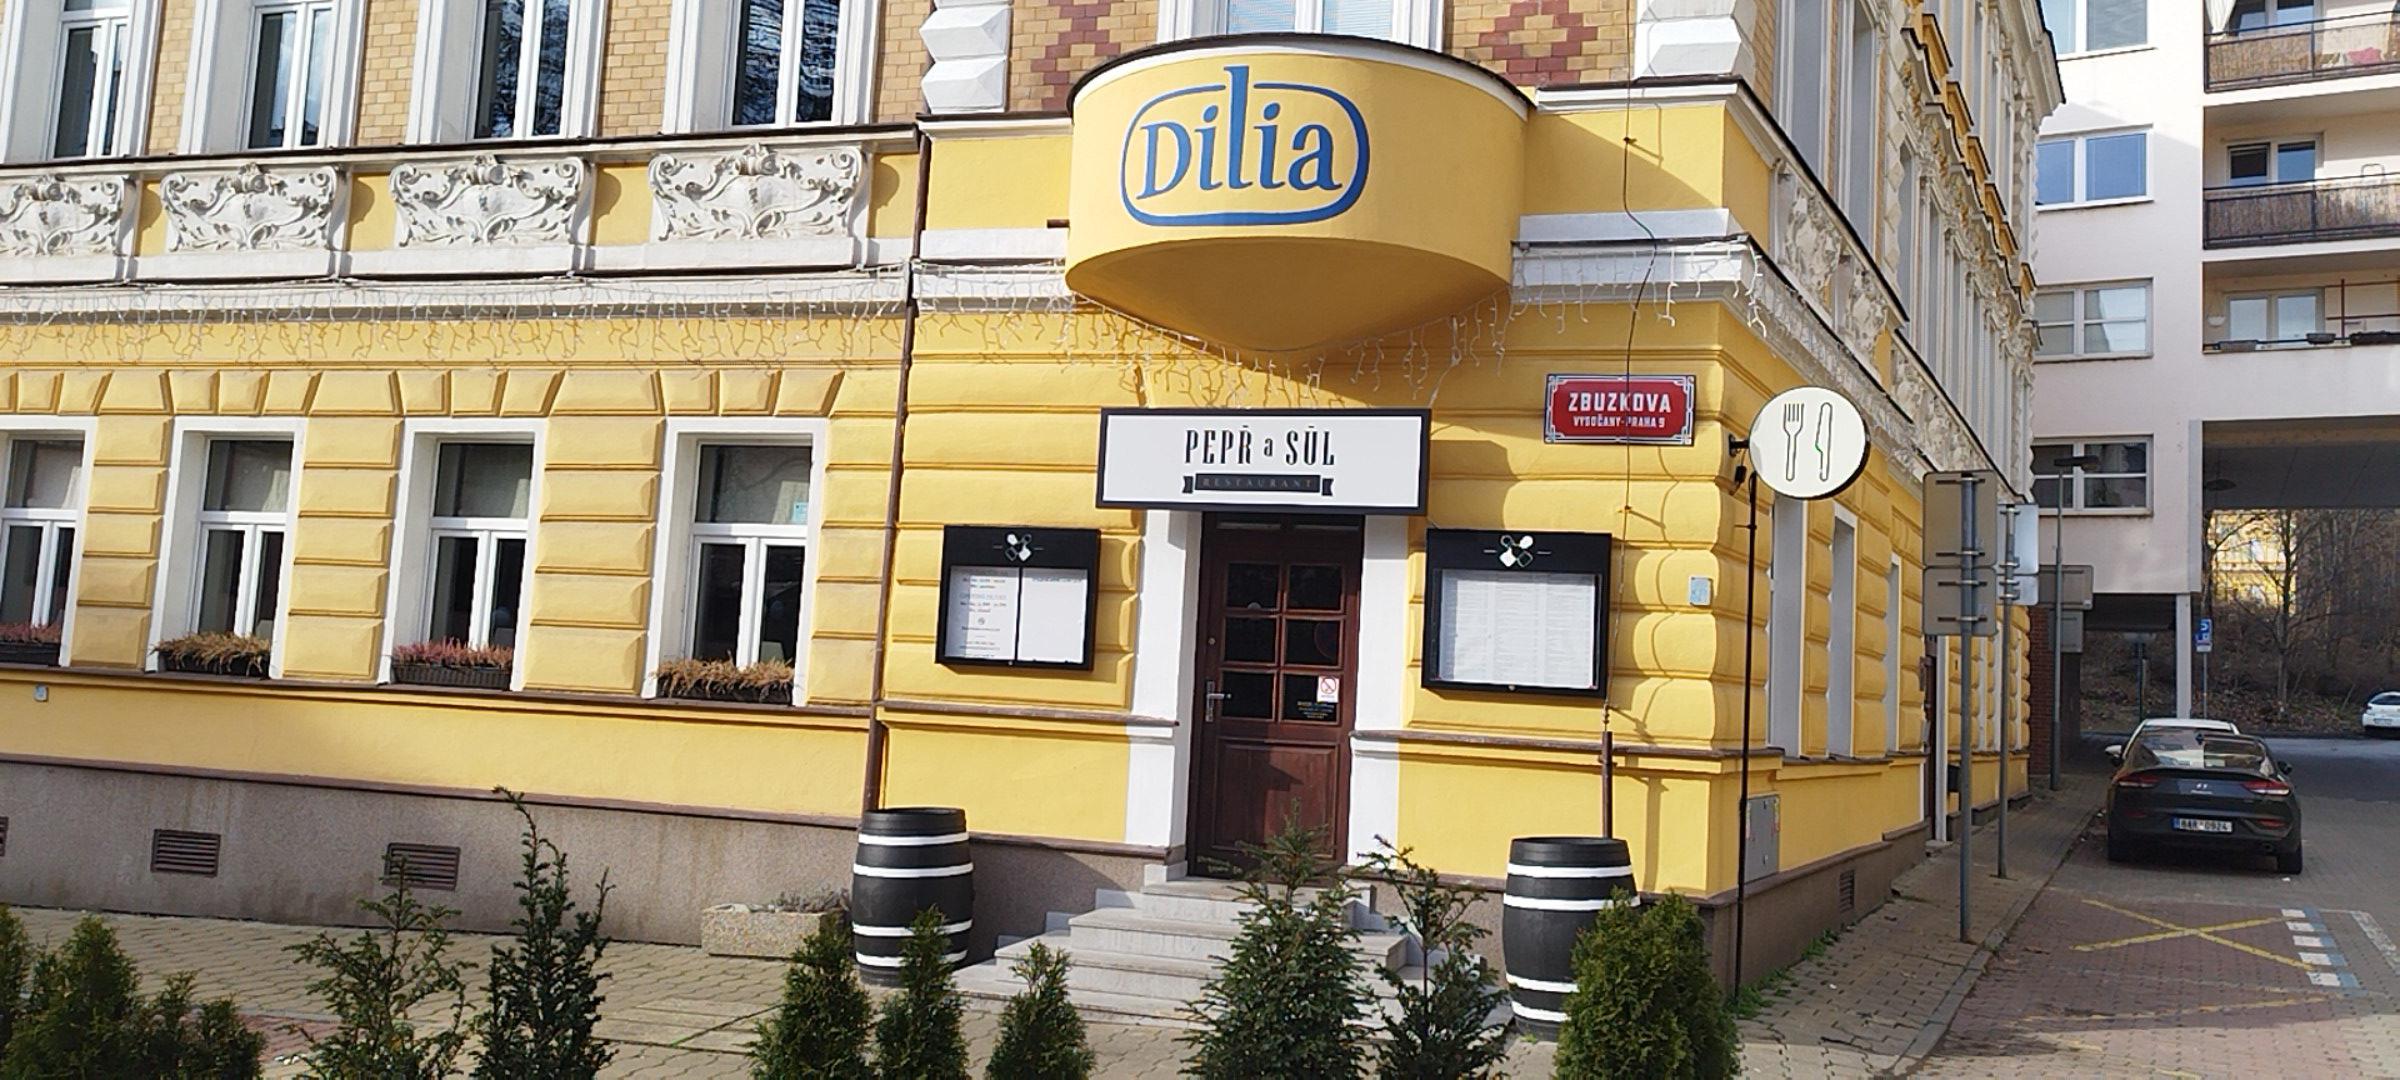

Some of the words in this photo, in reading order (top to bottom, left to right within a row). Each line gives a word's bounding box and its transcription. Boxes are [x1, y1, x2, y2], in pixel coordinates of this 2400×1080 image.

[1137, 66, 1343, 200] Dilia
[1569, 392, 1671, 413] ZBUZKOVA
[1658, 417, 1666, 428] 9
[1263, 438, 1274, 457] a
[1202, 478, 1312, 489] RESTAURANT
